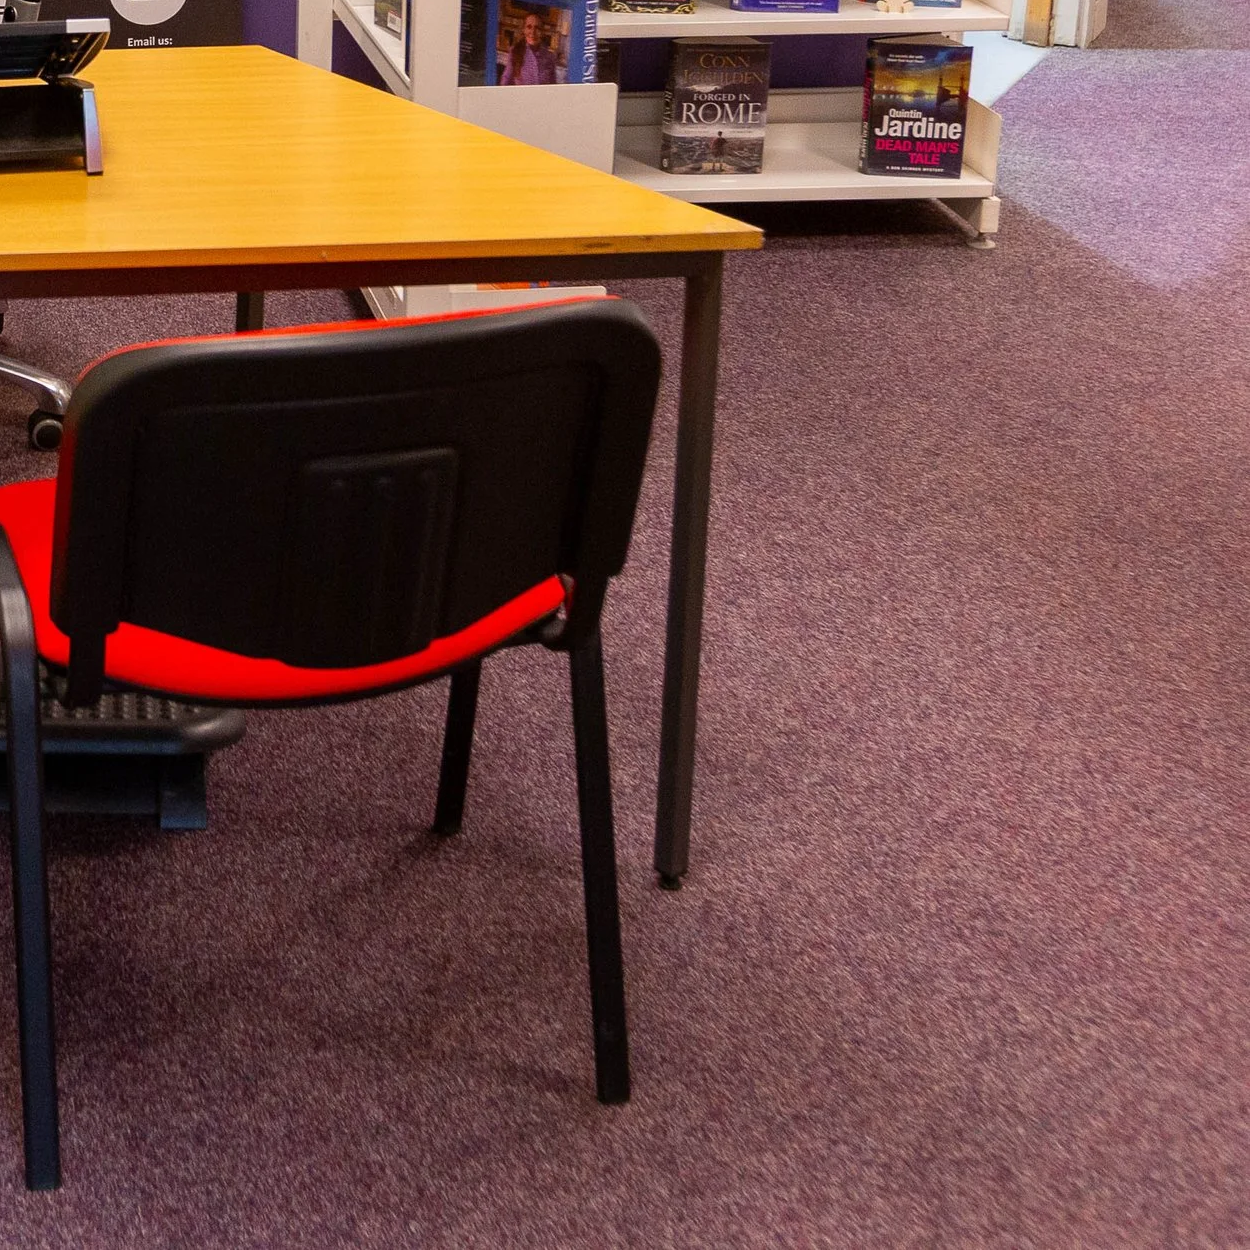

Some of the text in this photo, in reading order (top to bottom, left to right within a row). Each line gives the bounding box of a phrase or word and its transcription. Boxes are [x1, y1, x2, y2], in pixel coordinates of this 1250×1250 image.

[583, 0, 599, 62] Danielle
[127, 37, 173, 47] Email us:
[694, 93, 750, 101] FORGED IN
[681, 102, 762, 124] ROME
[889, 108, 922, 119] Quintin
[875, 115, 962, 139] Jardine
[875, 138, 959, 154] DEAD MAN'S
[908, 153, 941, 165] TALE
